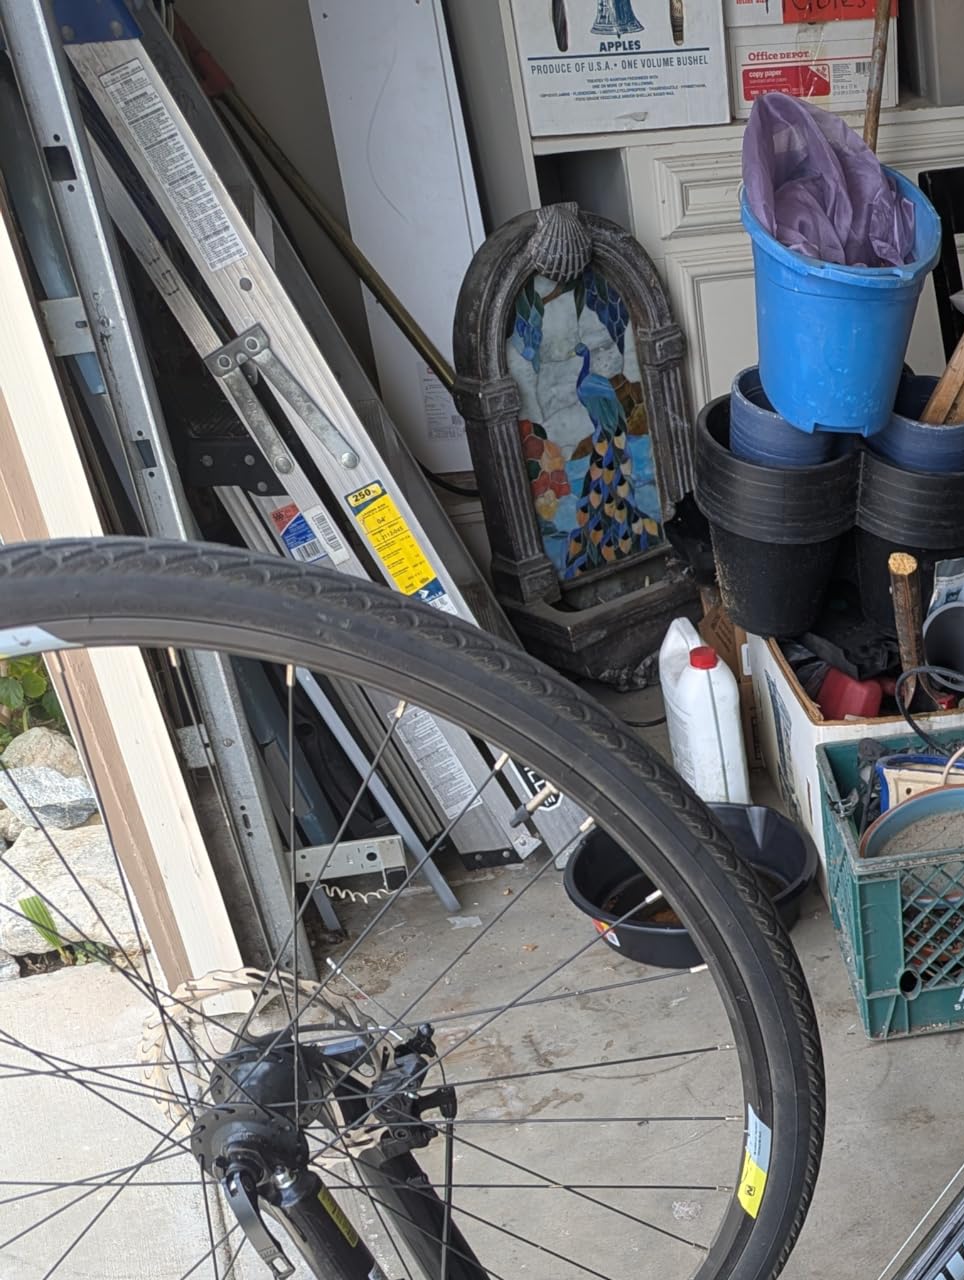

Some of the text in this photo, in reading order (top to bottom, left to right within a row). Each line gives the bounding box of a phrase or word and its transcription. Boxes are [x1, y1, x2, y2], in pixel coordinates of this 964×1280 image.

[599, 40, 641, 52] APPLES
[748, 51, 809, 61] Office DEPOT
[531, 63, 572, 75] PRODUCE
[575, 62, 586, 72] OF
[621, 58, 638, 70] ONE
[641, 57, 674, 68] VOLUME
[677, 55, 709, 66] BUSHEL
[352, 489, 372, 503] 250
